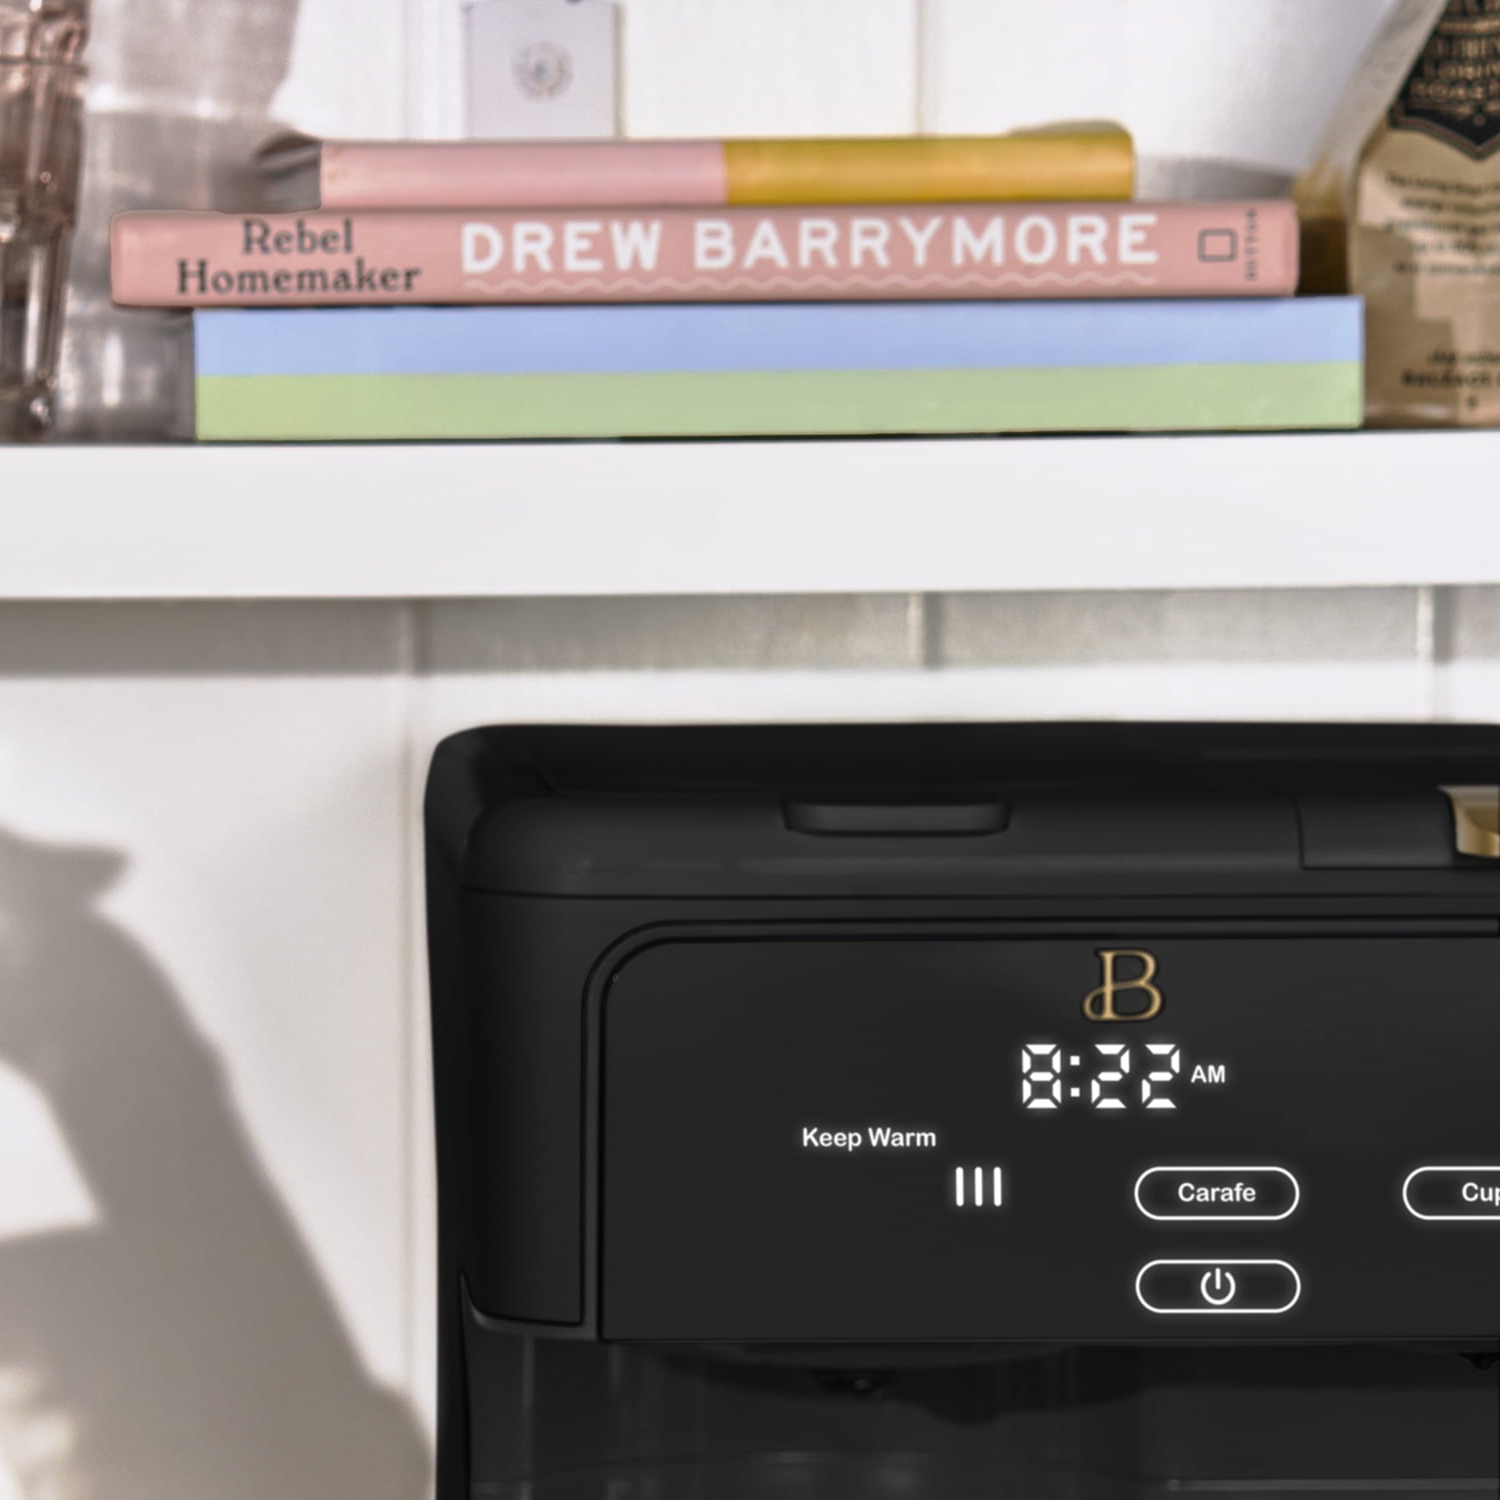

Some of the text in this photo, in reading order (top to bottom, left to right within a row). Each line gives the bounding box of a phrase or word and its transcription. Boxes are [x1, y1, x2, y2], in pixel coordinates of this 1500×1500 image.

[243, 217, 353, 255] Rebel
[460, 213, 1159, 273] DREW BARRYMORE
[177, 259, 422, 295] Homemaker
[1082, 950, 1164, 1021] B
[1021, 1043, 1227, 1109] 8:22 AM
[802, 1126, 937, 1152] Keep Warm
[1177, 1181, 1257, 1203] Carafe
